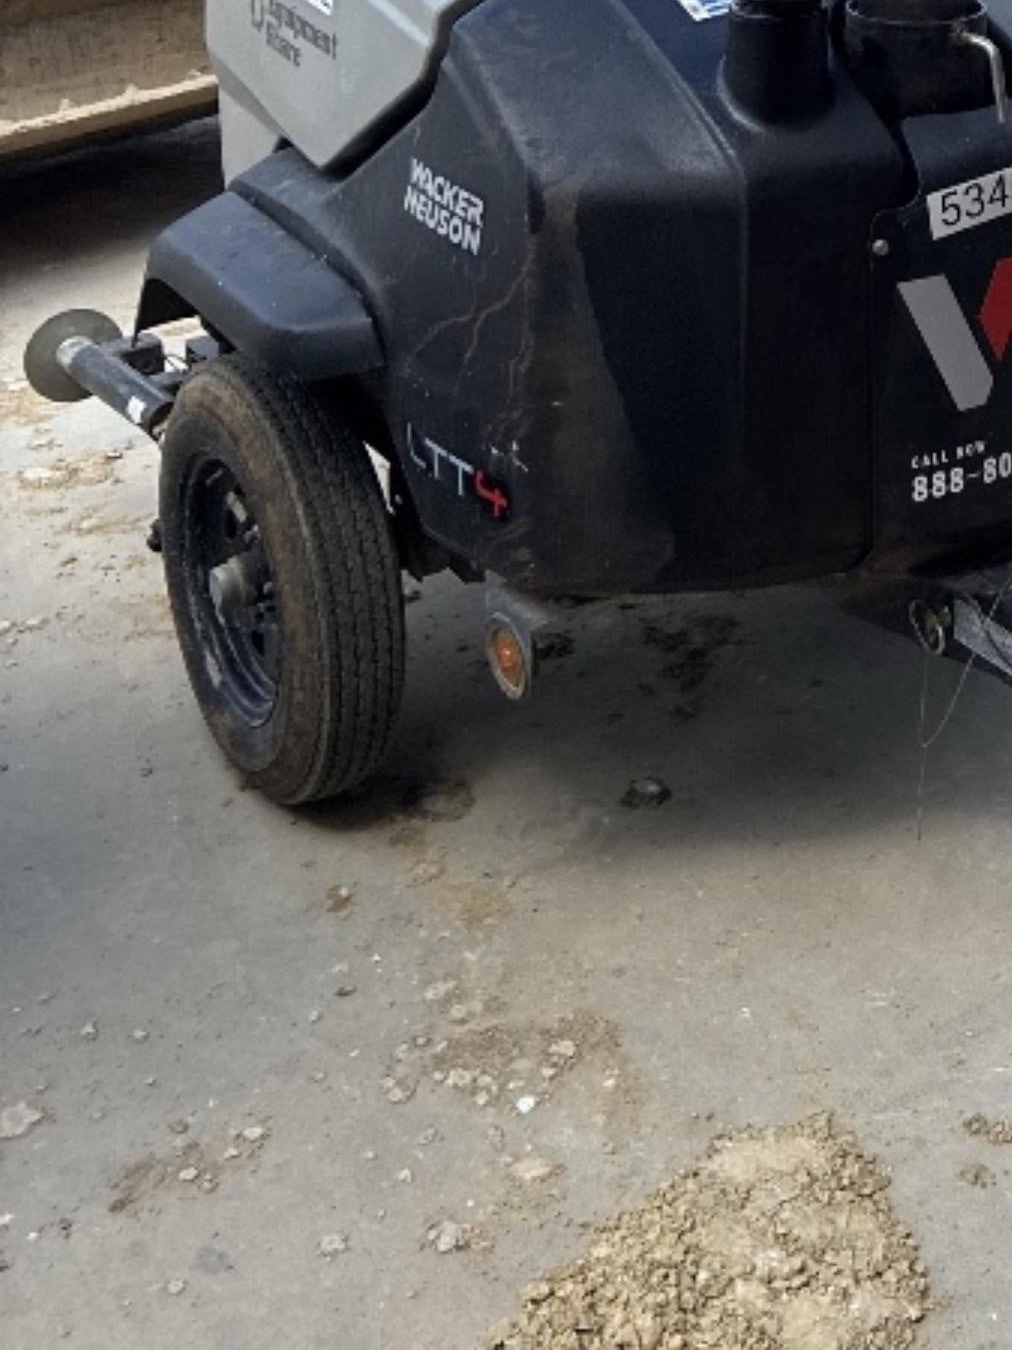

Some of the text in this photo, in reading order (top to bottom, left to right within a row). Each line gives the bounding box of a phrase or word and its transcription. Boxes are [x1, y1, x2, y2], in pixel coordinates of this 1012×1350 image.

[404, 184, 481, 256] NEUSON
[410, 157, 484, 228] WACKER
[910, 440, 986, 470] CALL NOW
